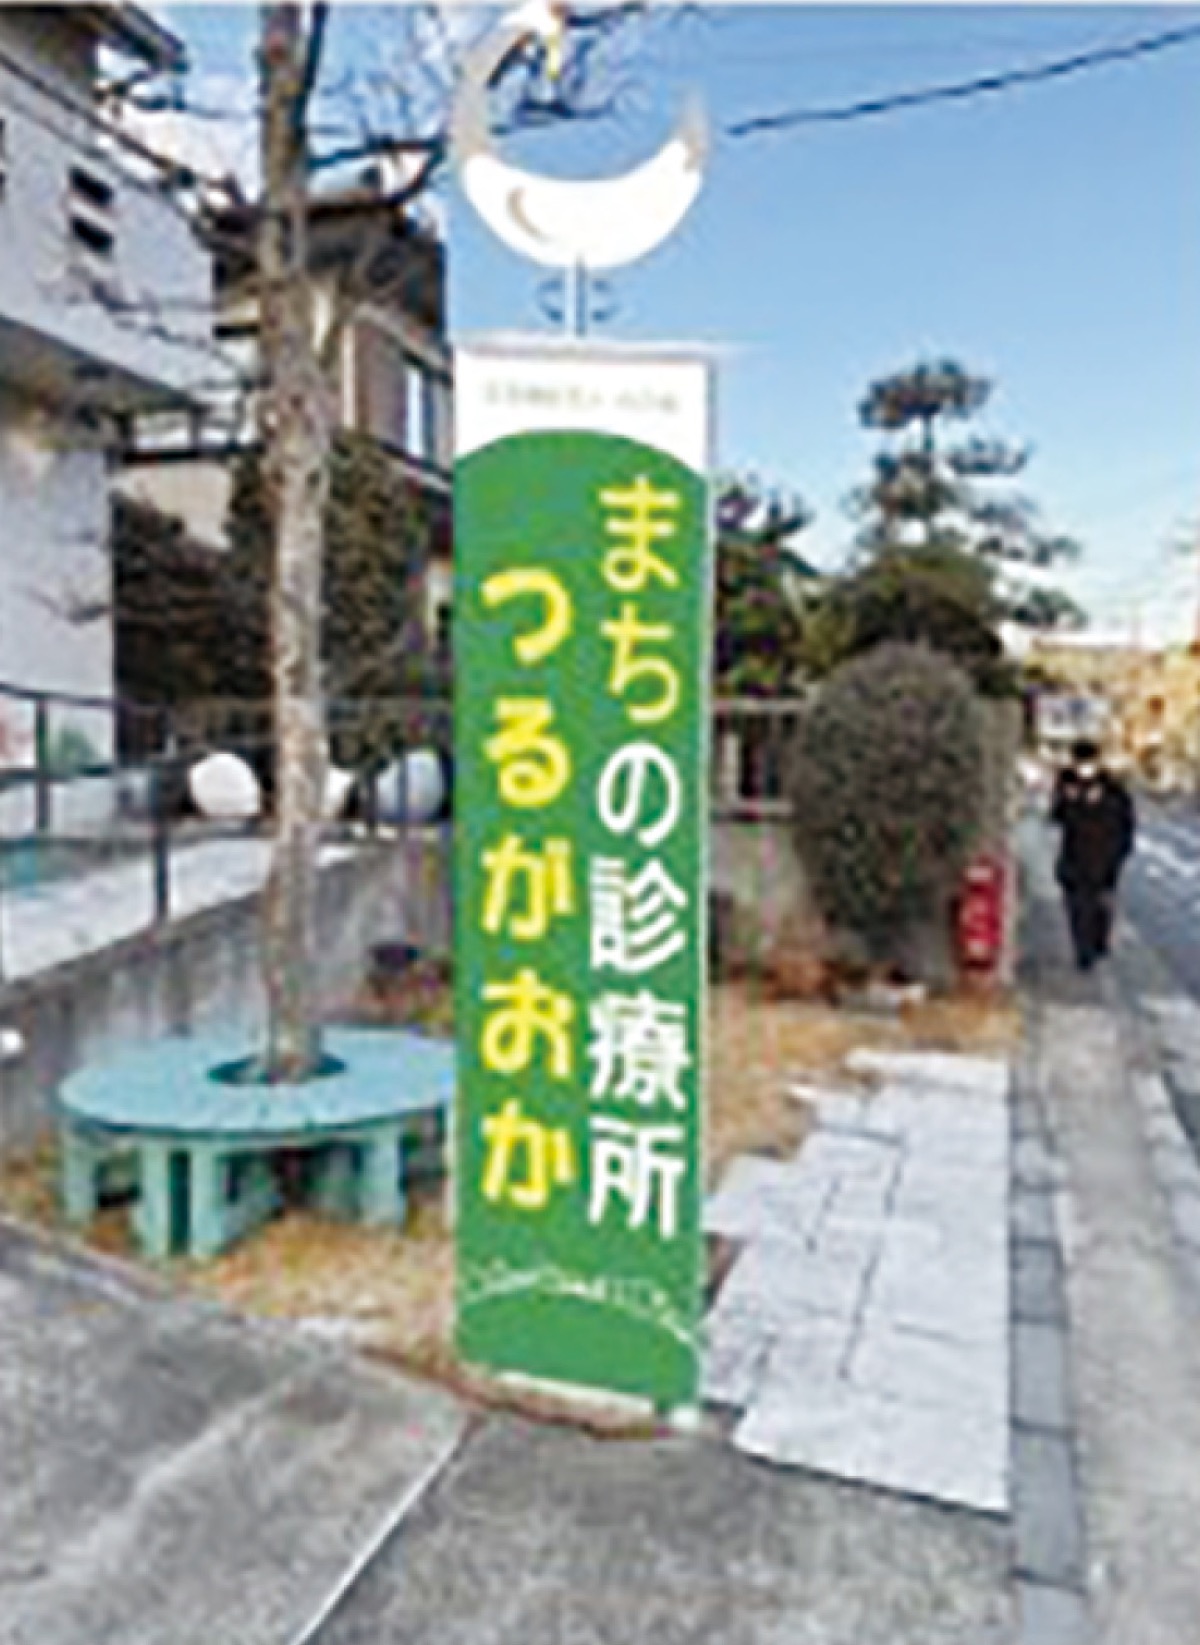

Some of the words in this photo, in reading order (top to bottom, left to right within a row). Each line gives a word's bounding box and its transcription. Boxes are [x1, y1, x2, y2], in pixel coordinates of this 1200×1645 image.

[481, 567, 574, 1207] つるがおか
[586, 475, 690, 1239] まちの診療所
